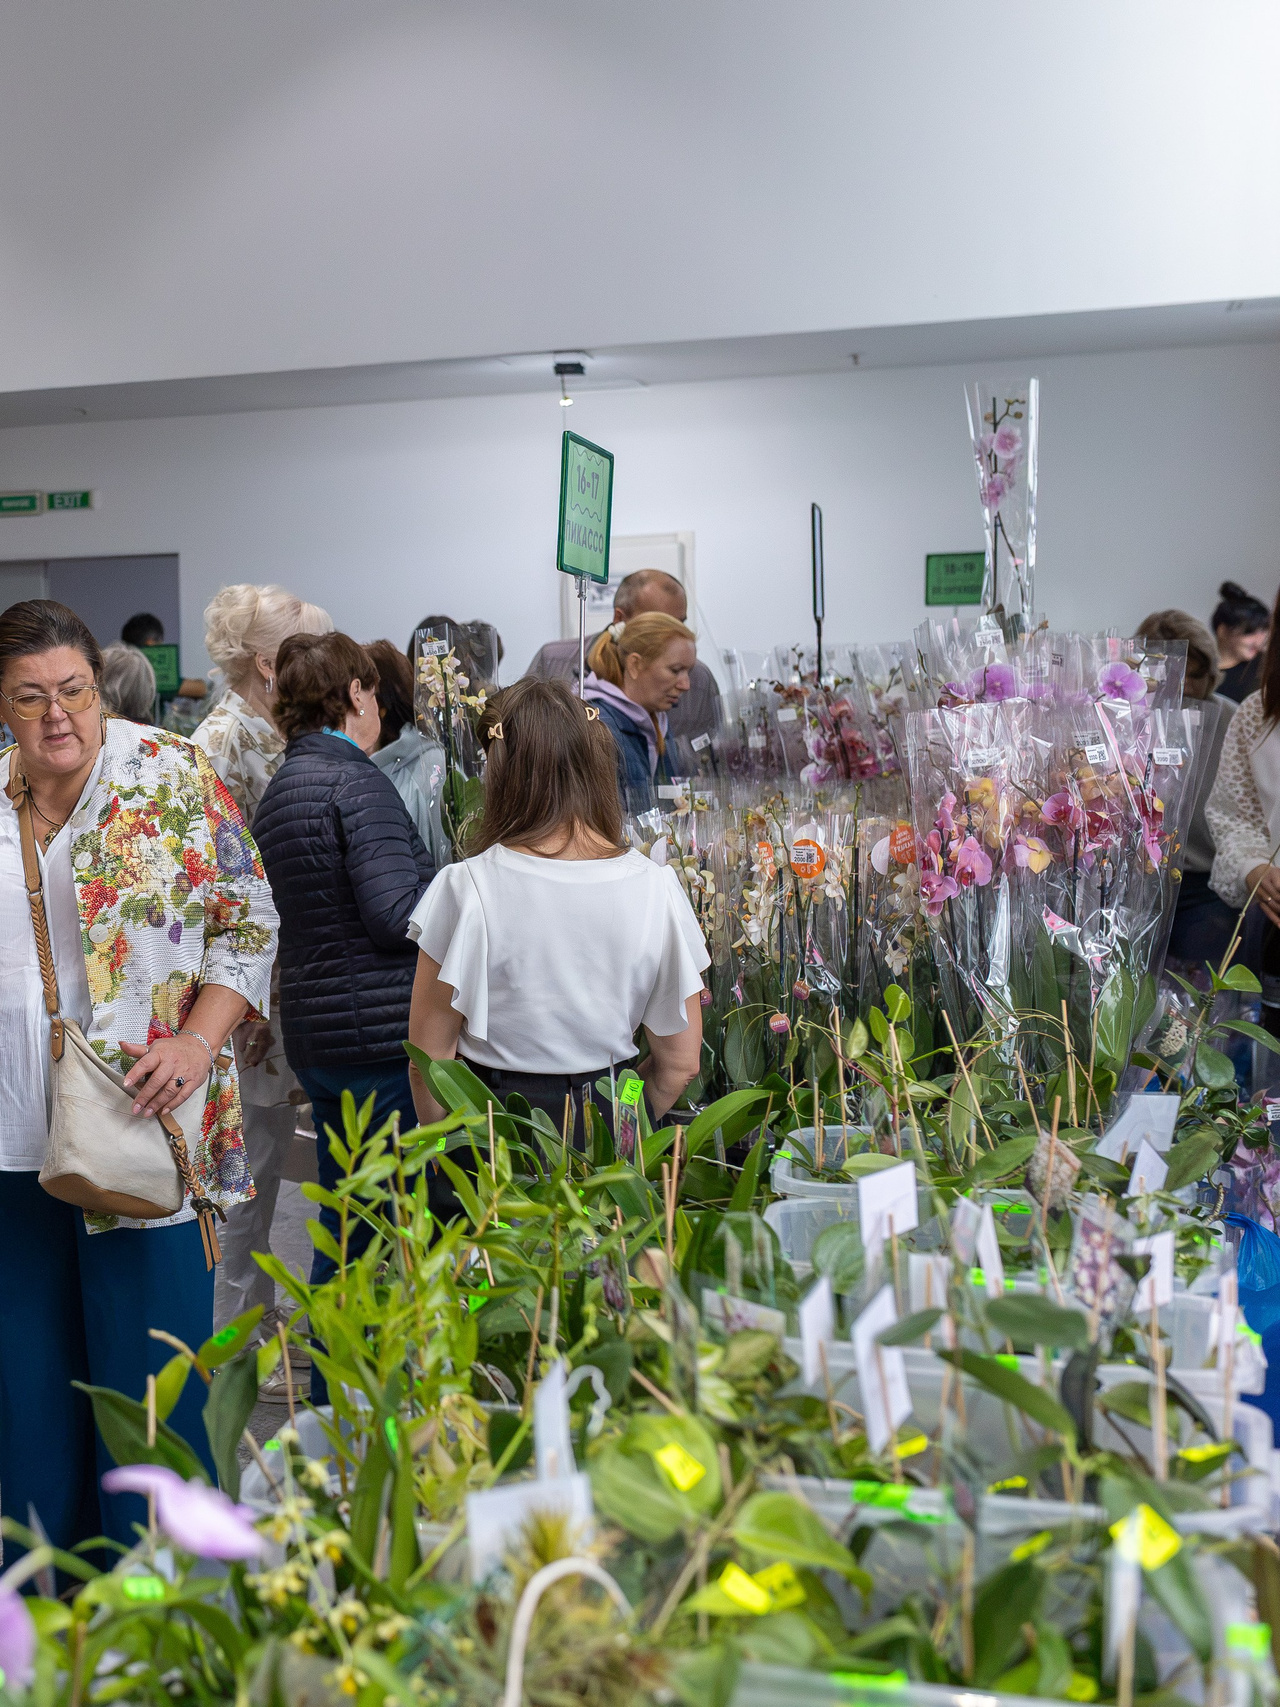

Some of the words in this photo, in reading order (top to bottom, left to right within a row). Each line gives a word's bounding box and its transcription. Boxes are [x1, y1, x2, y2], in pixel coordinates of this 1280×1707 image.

[577, 464, 600, 500] 16-17
[54, 493, 83, 508] EXIT
[565, 518, 604, 555] ПИКАССО
